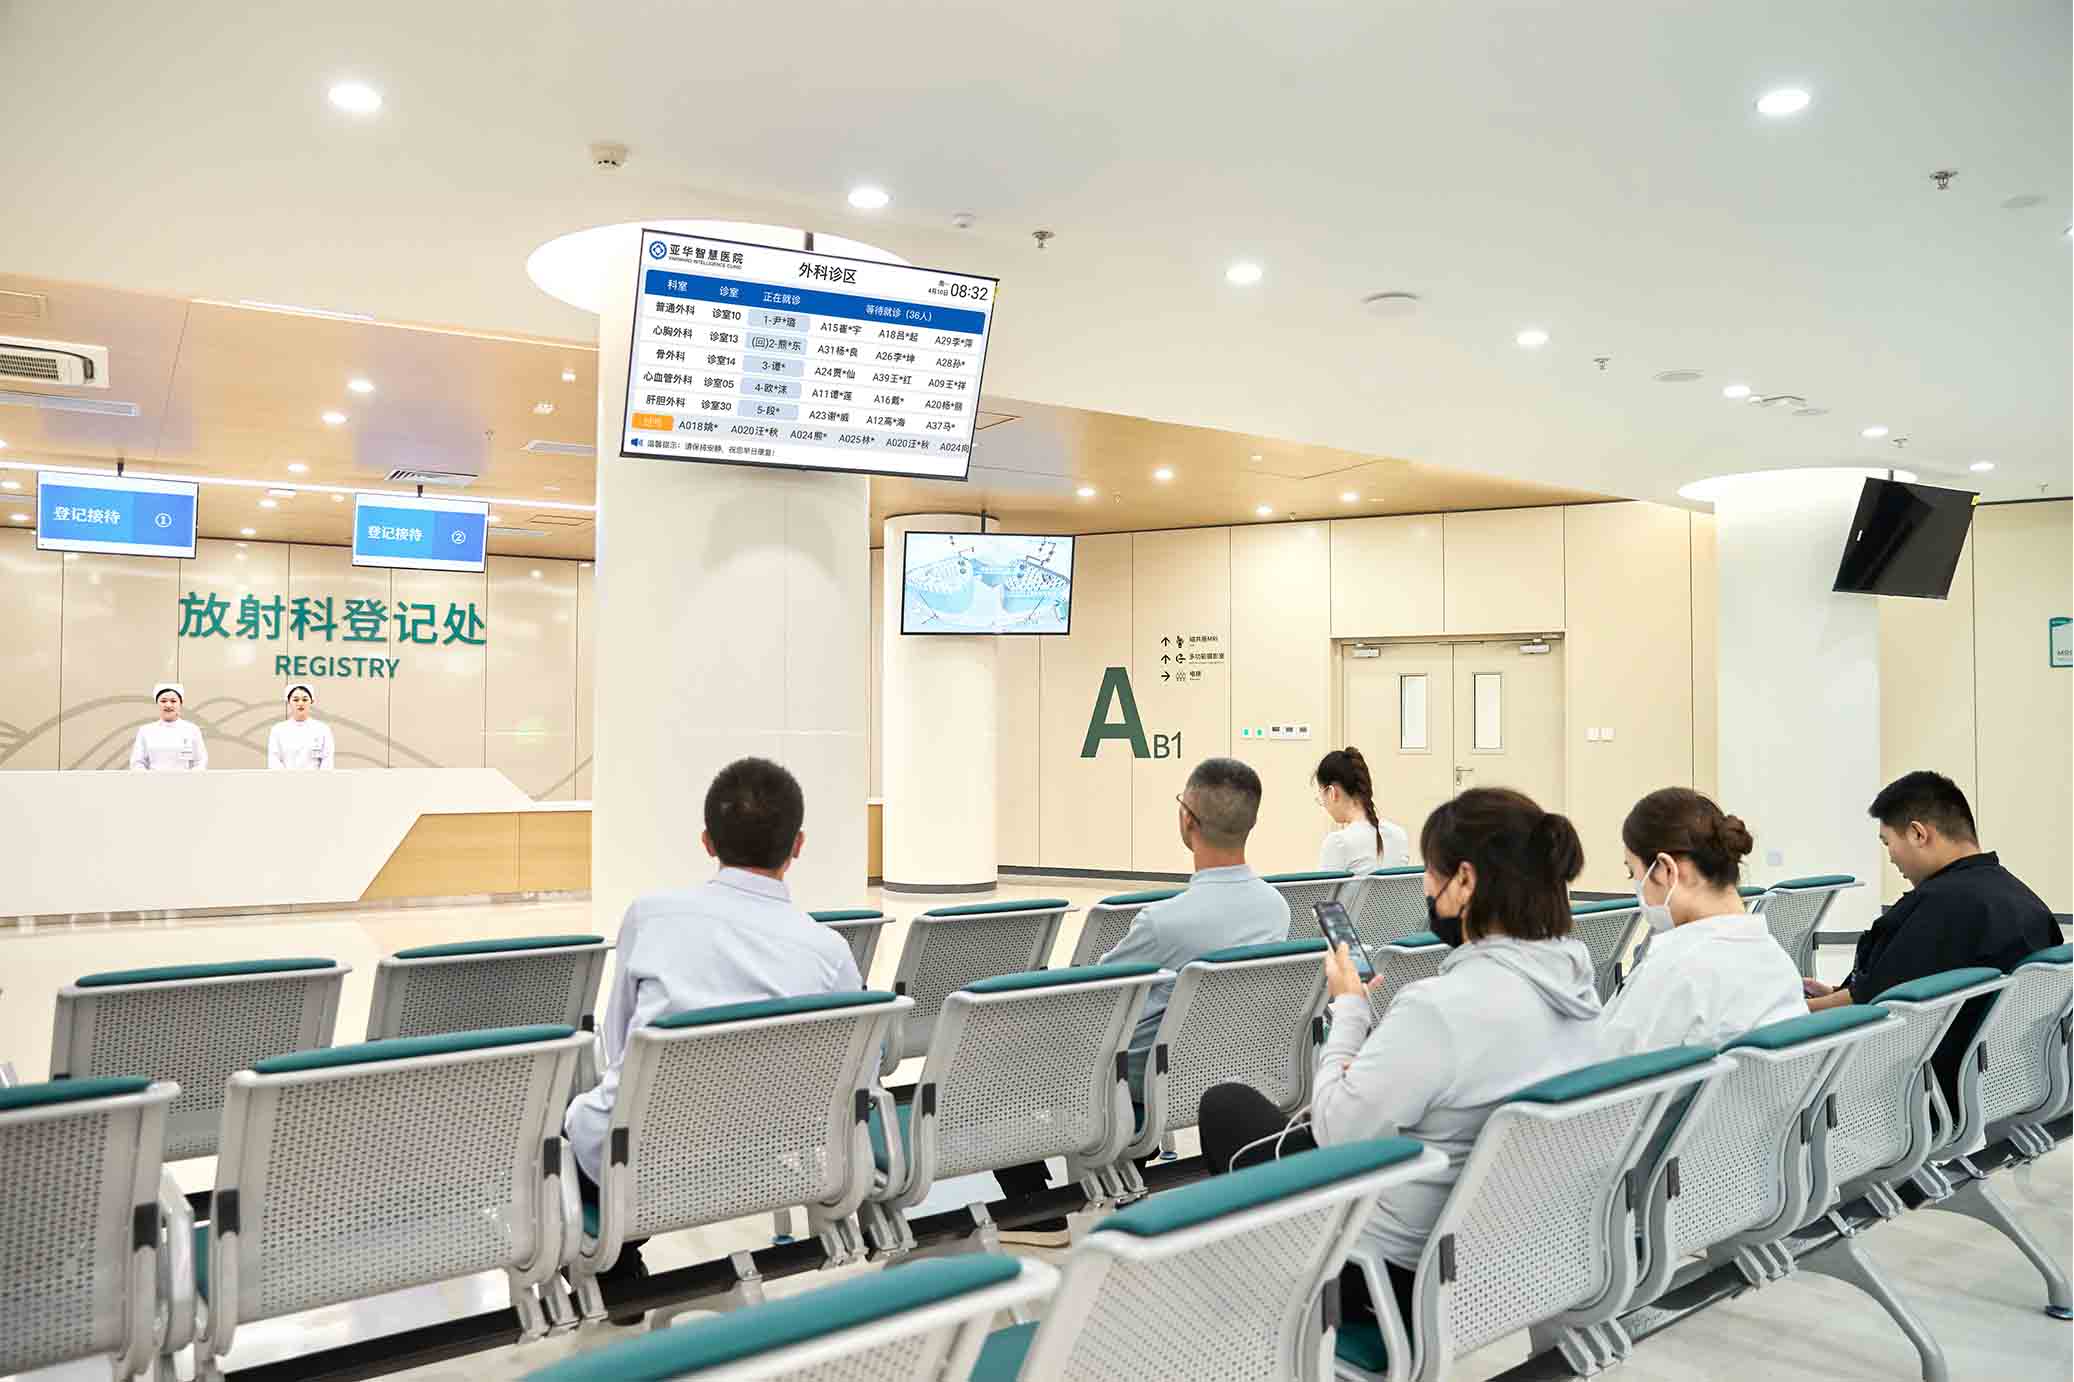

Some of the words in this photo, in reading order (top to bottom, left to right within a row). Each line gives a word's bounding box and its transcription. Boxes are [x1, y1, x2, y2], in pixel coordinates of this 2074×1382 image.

[670, 244, 744, 264] 亚华智慧医院
[799, 263, 857, 284] 外科诊区
[667, 279, 688, 292] 科室
[719, 286, 739, 297] 诊室
[950, 283, 988, 300] 08:32
[763, 291, 801, 305] 正在就诊
[655, 301, 695, 316] 普通外科
[712, 308, 742, 321] 诊室10
[653, 325, 693, 339] 心胸外科
[709, 331, 739, 344] 诊室13
[656, 349, 686, 362] 骨外科
[707, 354, 736, 366] 诊室14
[643, 371, 693, 385] 心血管外科
[704, 377, 735, 389] 诊室05
[646, 394, 686, 408] 肝胆外科
[701, 400, 732, 412] 诊室30
[53, 506, 121, 524] 登记接待
[367, 525, 423, 542] 登记接待
[178, 592, 487, 645] 放射科登记处
[275, 655, 400, 679] REGISTRY
[1081, 667, 1151, 758] A
[1154, 731, 1181, 759] B1
